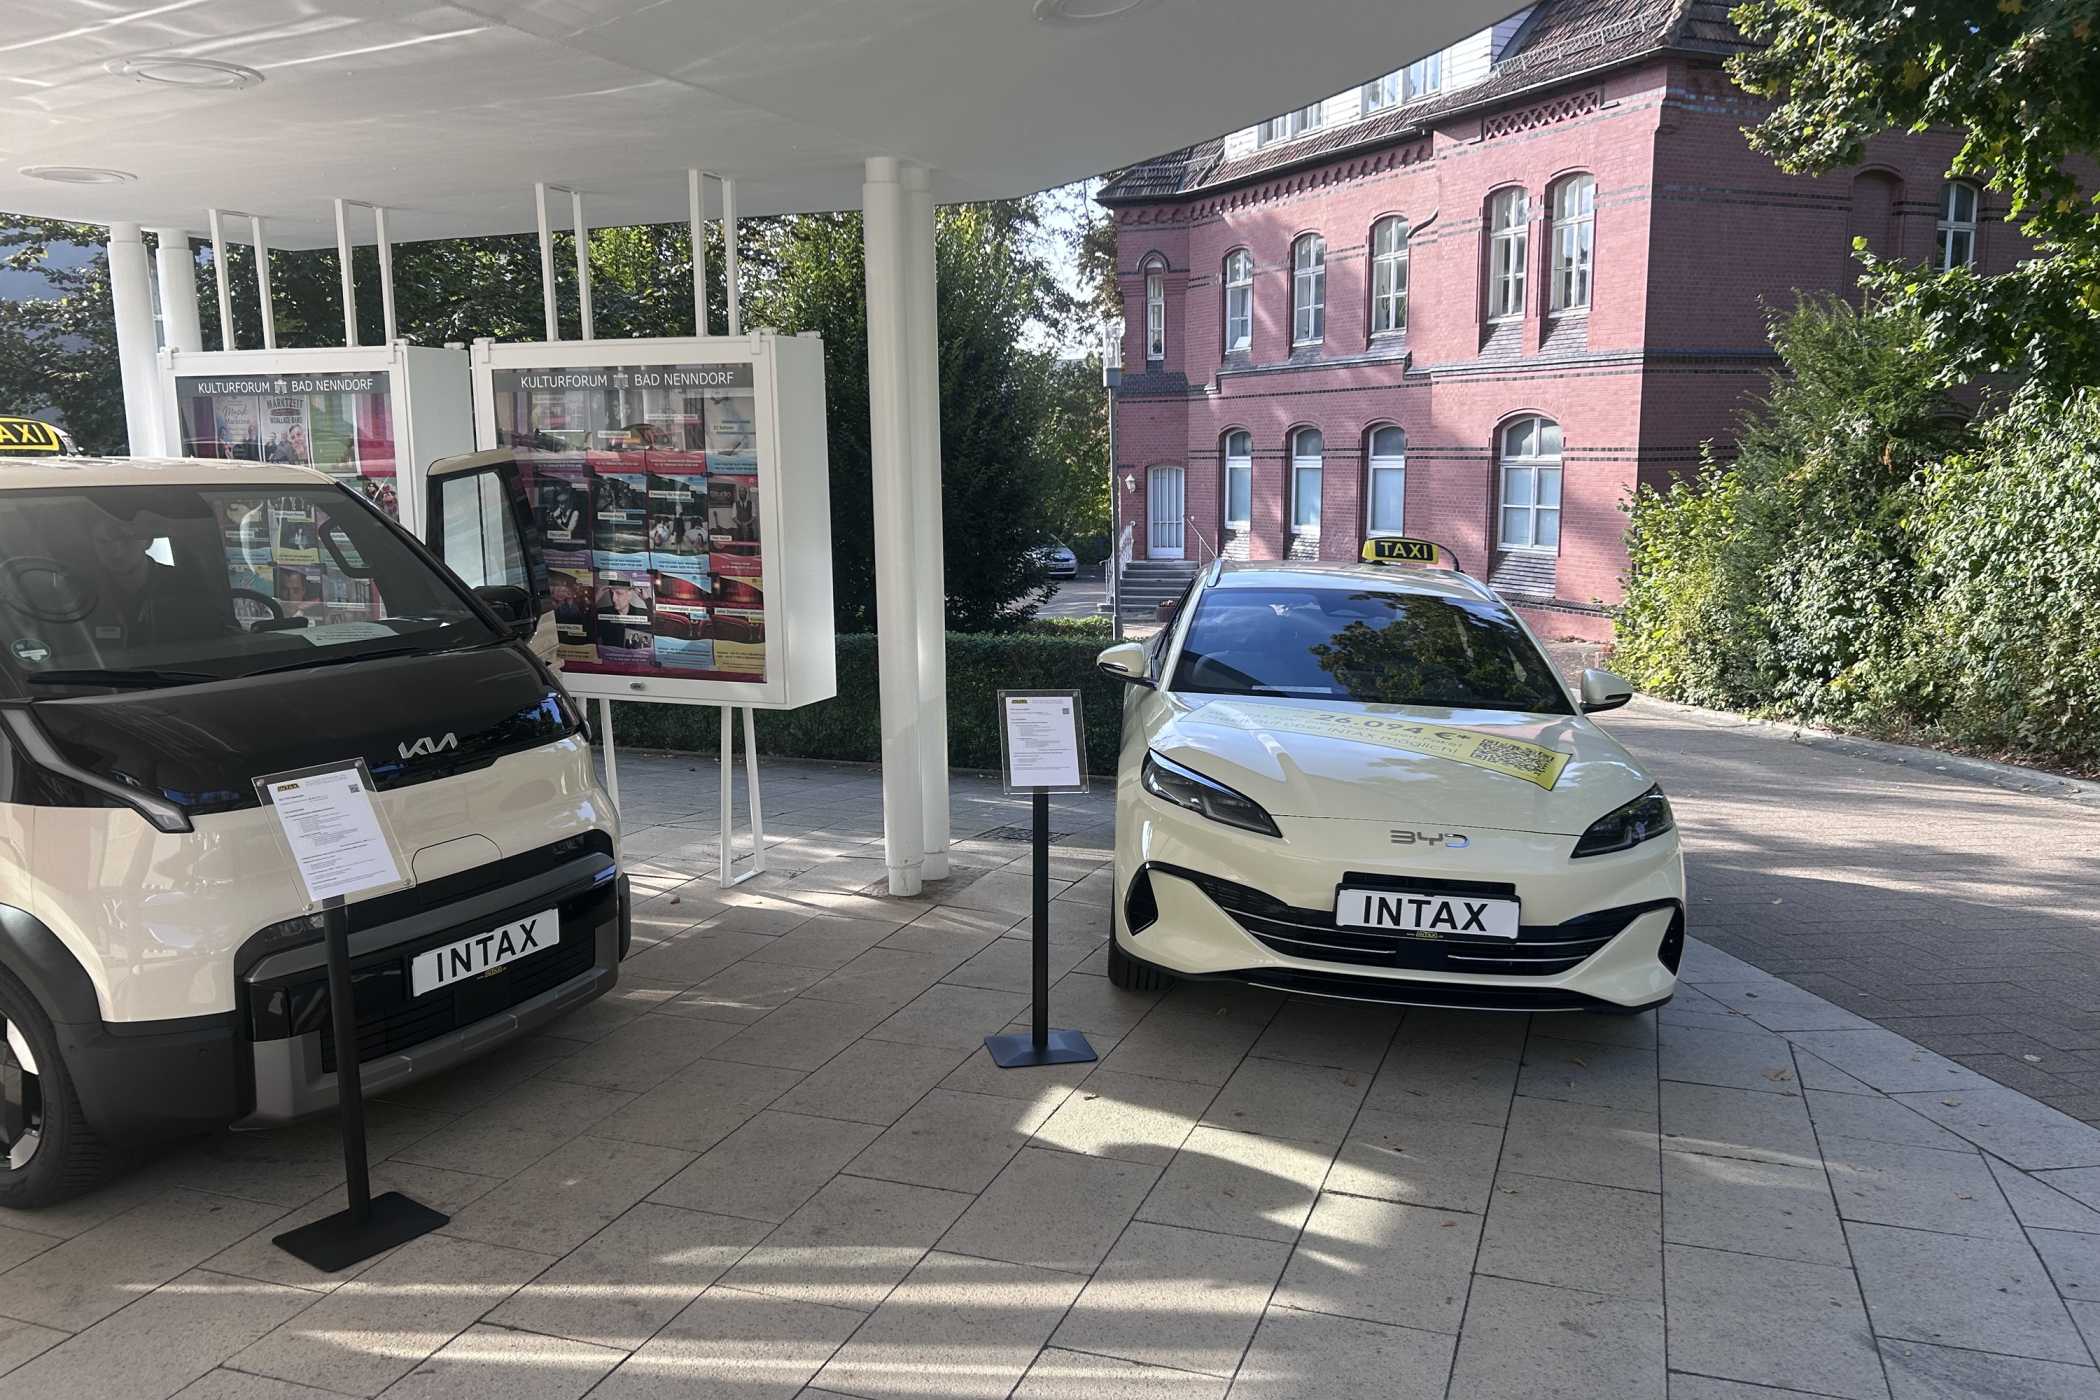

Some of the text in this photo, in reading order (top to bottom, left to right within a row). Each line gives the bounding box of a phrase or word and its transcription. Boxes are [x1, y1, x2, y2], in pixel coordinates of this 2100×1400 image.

[198, 378, 374, 394] KULTURFORUM BAD NENNDORF
[520, 371, 734, 388] KULTURFORUM BAD NENNDORF
[266, 398, 304, 409] MARKTZEIT
[0, 424, 46, 443] AXI
[1381, 542, 1428, 559] TAXI
[1313, 714, 1424, 734] 26.094
[1327, 727, 1375, 740] INTAX
[398, 732, 458, 759] KIA
[1390, 829, 1471, 848] BYD
[1363, 895, 1489, 932] INTAX
[437, 919, 539, 983] INTAX
